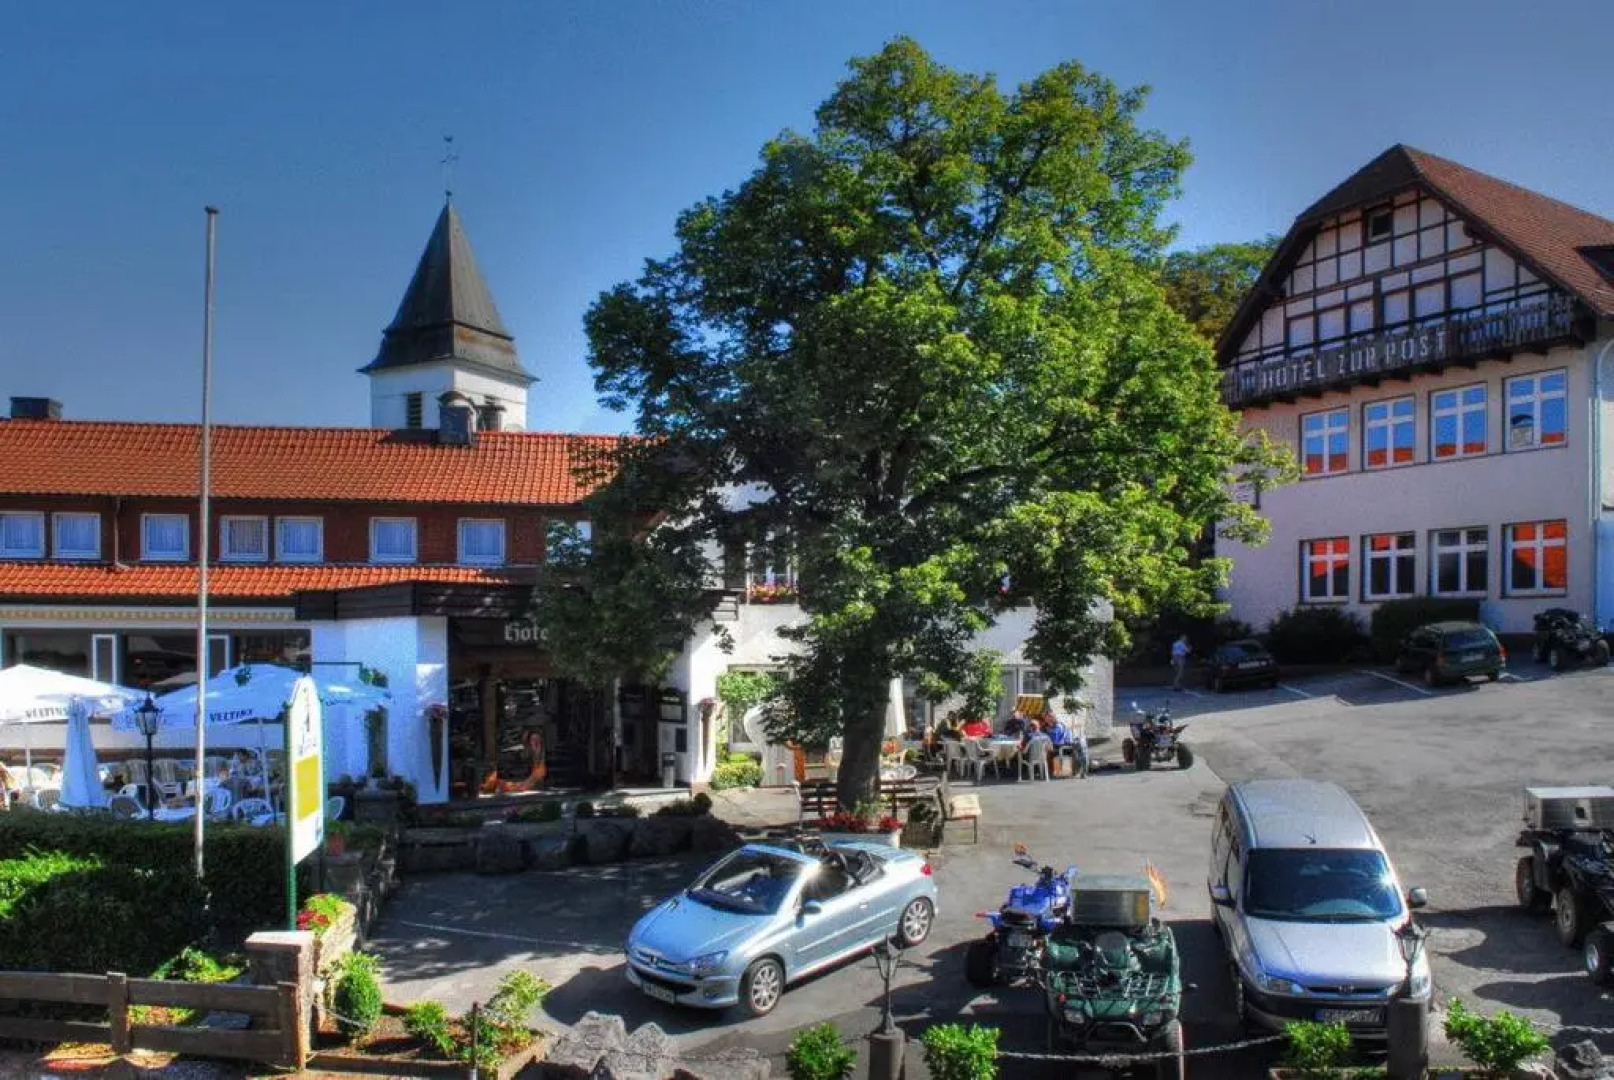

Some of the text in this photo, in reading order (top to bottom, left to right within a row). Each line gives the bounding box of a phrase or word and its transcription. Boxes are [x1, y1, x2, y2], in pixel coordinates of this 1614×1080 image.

[1262, 358, 1325, 389] HOTEL
[1386, 331, 1446, 365] POST
[504, 622, 549, 642] Hote
